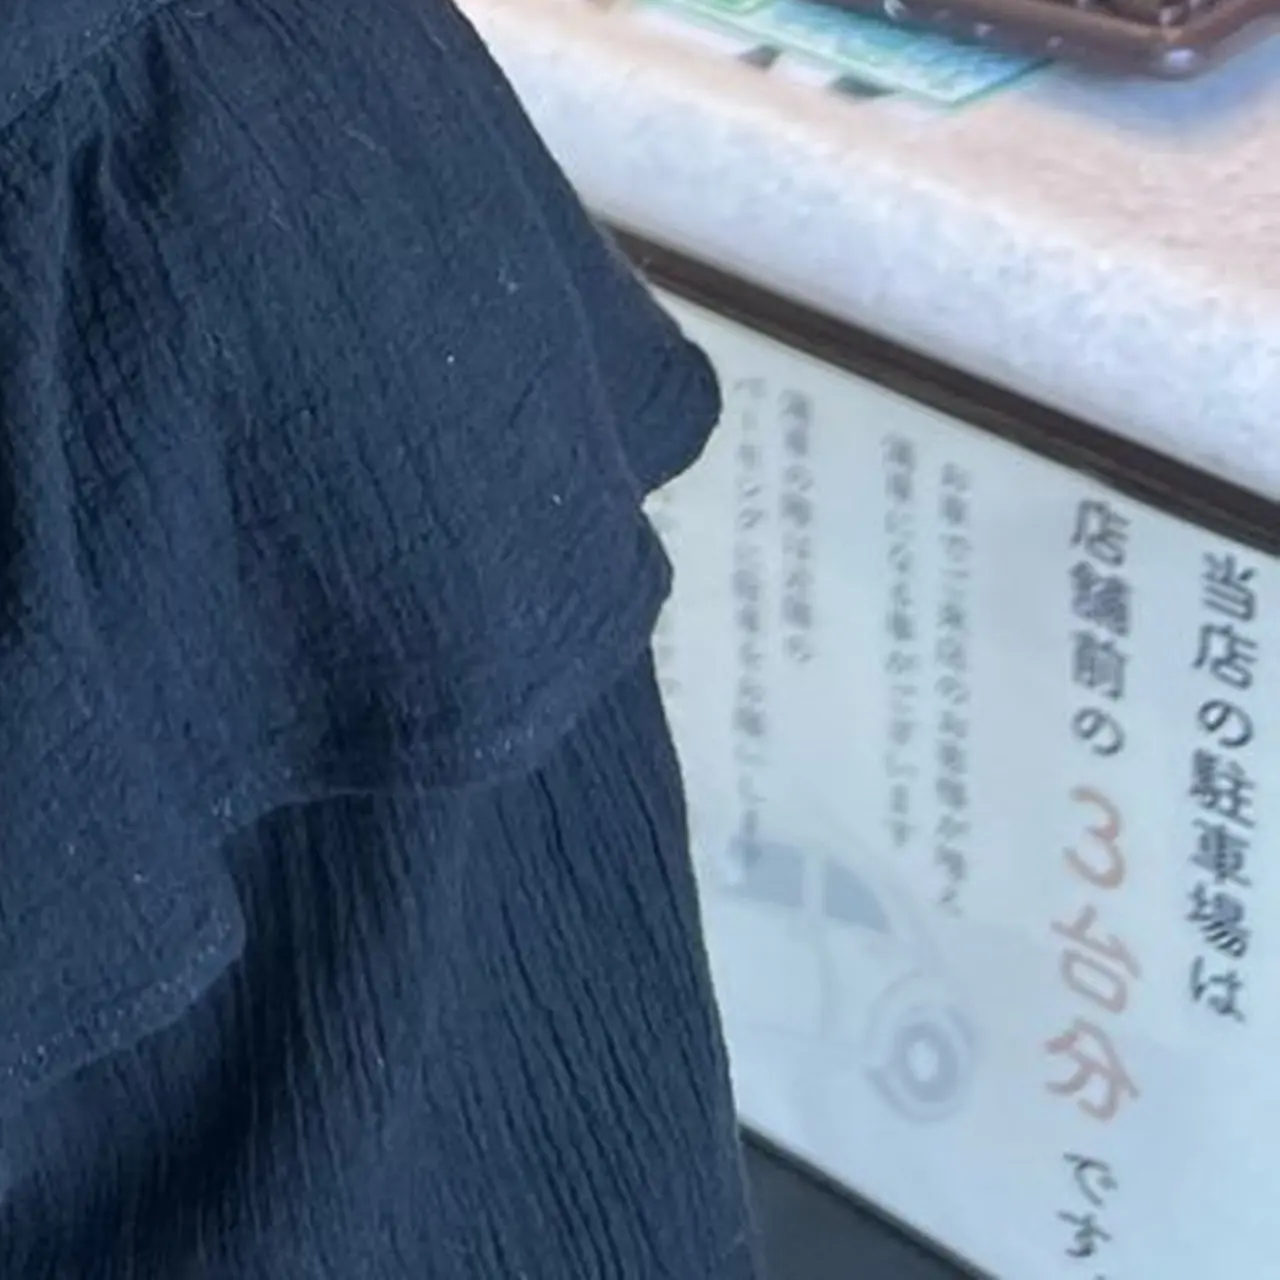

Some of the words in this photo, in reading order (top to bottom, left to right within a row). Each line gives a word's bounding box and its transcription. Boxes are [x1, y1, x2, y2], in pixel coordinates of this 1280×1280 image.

[1045, 497, 1141, 1280] 店舗前の3台分です
[1186, 550, 1258, 1024] 当店の駐車場は
